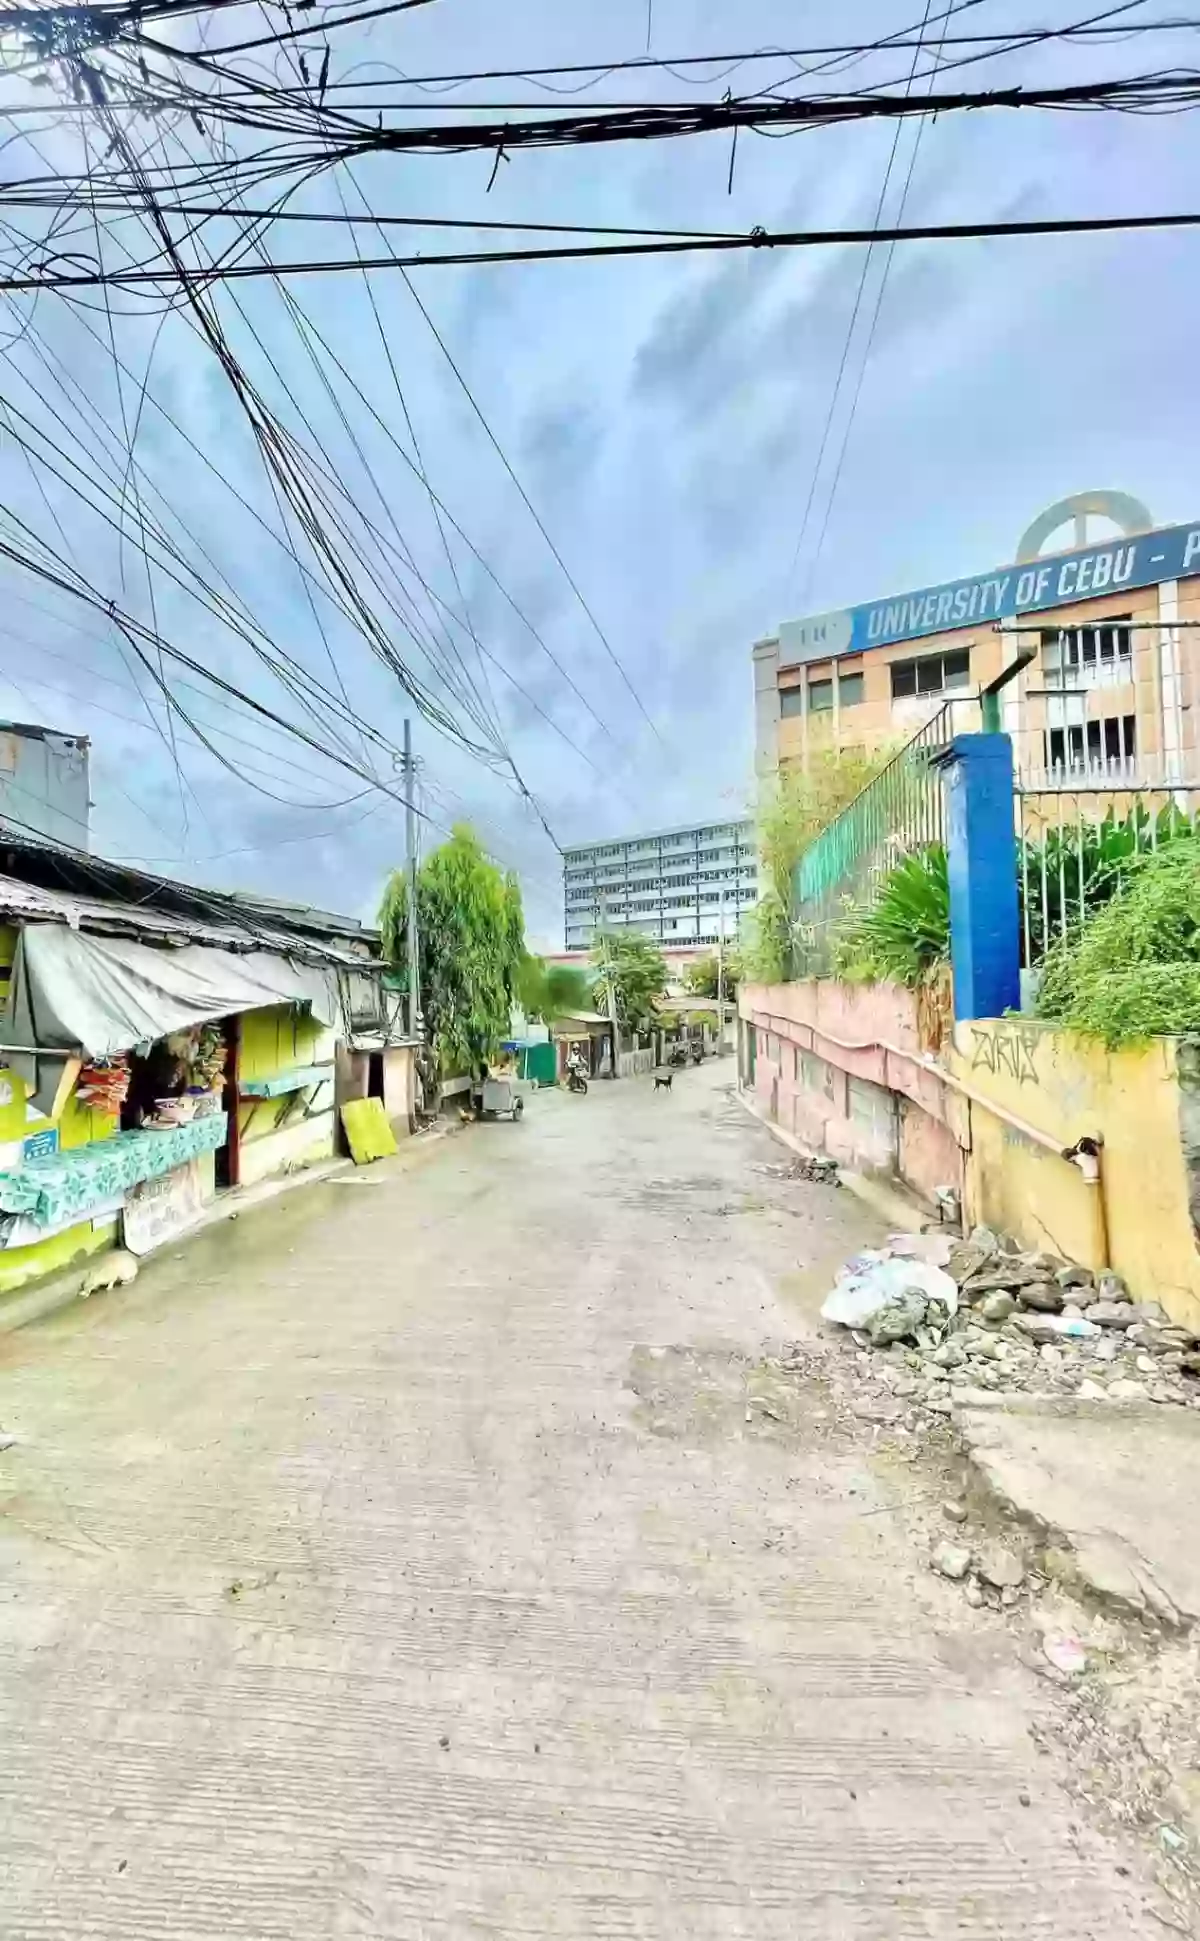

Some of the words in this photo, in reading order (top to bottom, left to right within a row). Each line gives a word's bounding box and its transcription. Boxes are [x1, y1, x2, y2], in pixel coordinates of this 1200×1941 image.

[867, 575, 1009, 639] UNIVERSITY
[1016, 567, 1051, 605] OF
[1057, 546, 1136, 596] CEBU
